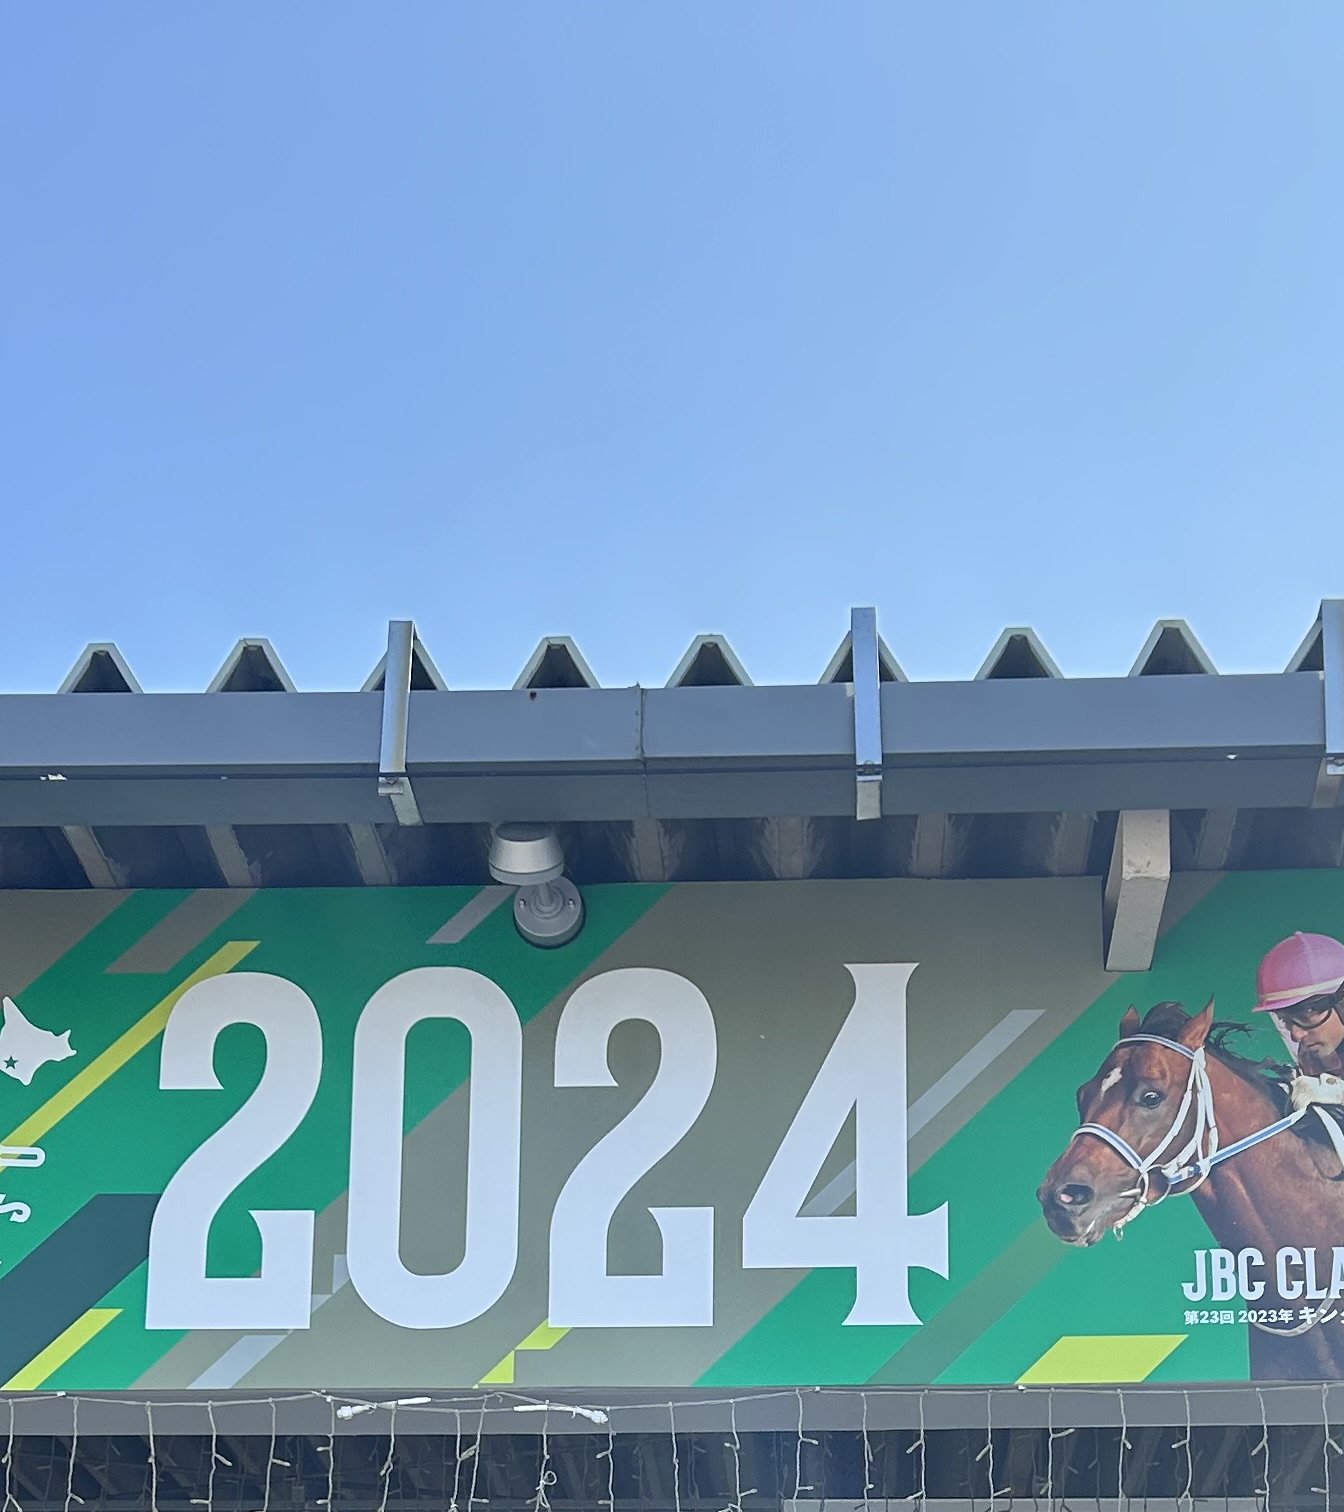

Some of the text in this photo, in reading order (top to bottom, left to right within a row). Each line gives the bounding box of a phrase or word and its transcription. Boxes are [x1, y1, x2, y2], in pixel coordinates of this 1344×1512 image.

[145, 963, 949, 1330] 2024
[1181, 1247, 1266, 1302] JBC
[1183, 1309, 1235, 1325] 第23回
[1238, 1308, 1295, 1324] 2023年
